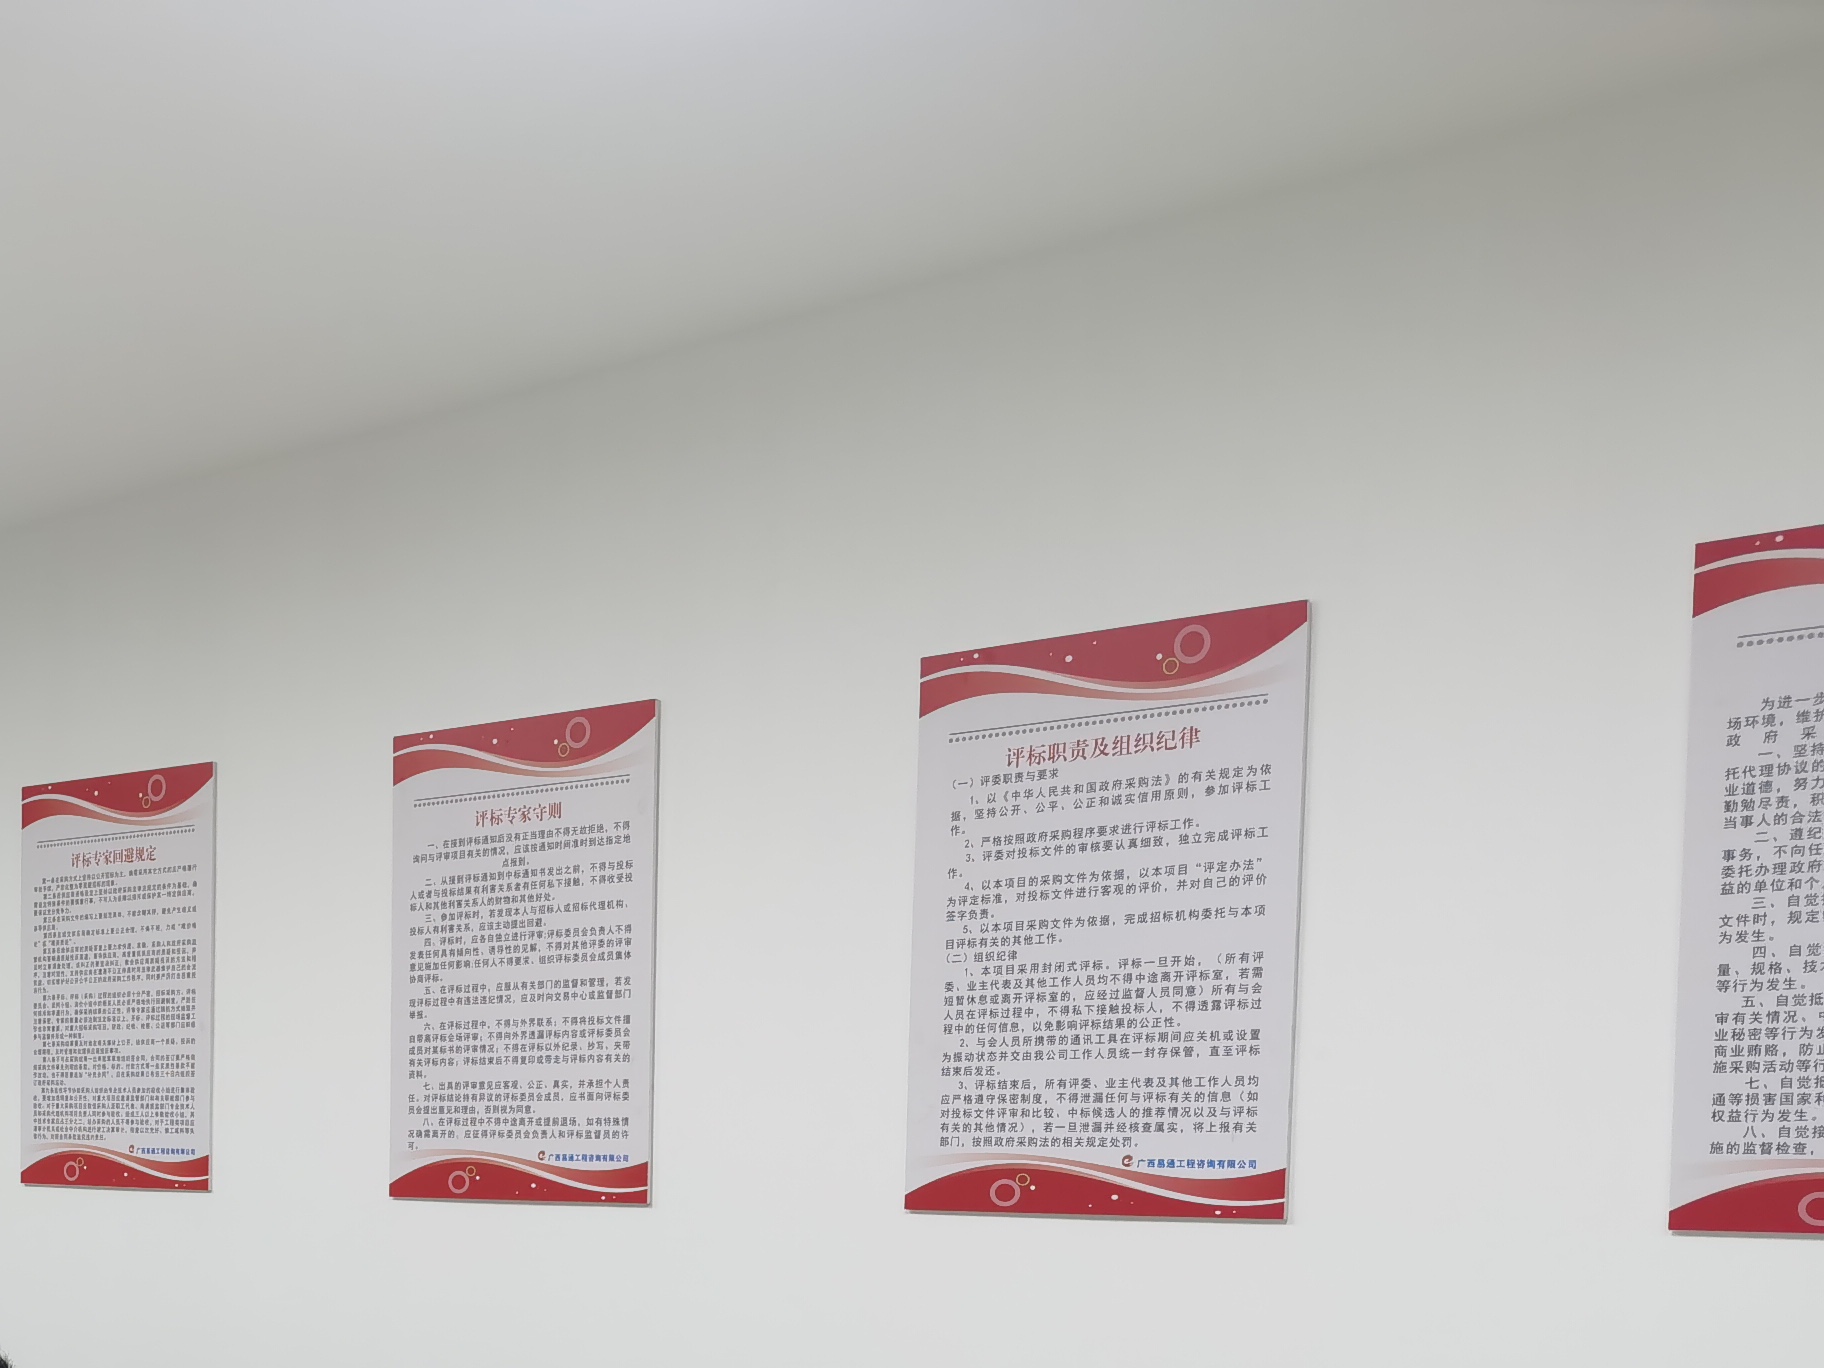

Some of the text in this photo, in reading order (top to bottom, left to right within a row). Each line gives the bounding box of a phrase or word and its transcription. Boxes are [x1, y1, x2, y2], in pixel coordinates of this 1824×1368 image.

[1004, 725, 1201, 769] 评标职责及组织纪律
[475, 801, 562, 828] 评标专家守则
[1719, 875, 1820, 896] 益的单位和个
[1750, 892, 1819, 910] 三、自觉
[945, 908, 994, 922] 签字负责。
[1718, 908, 1820, 929] 文件时，规定
[1751, 942, 1821, 960] 四、自觉
[1716, 959, 1823, 977] 量、规格、技
